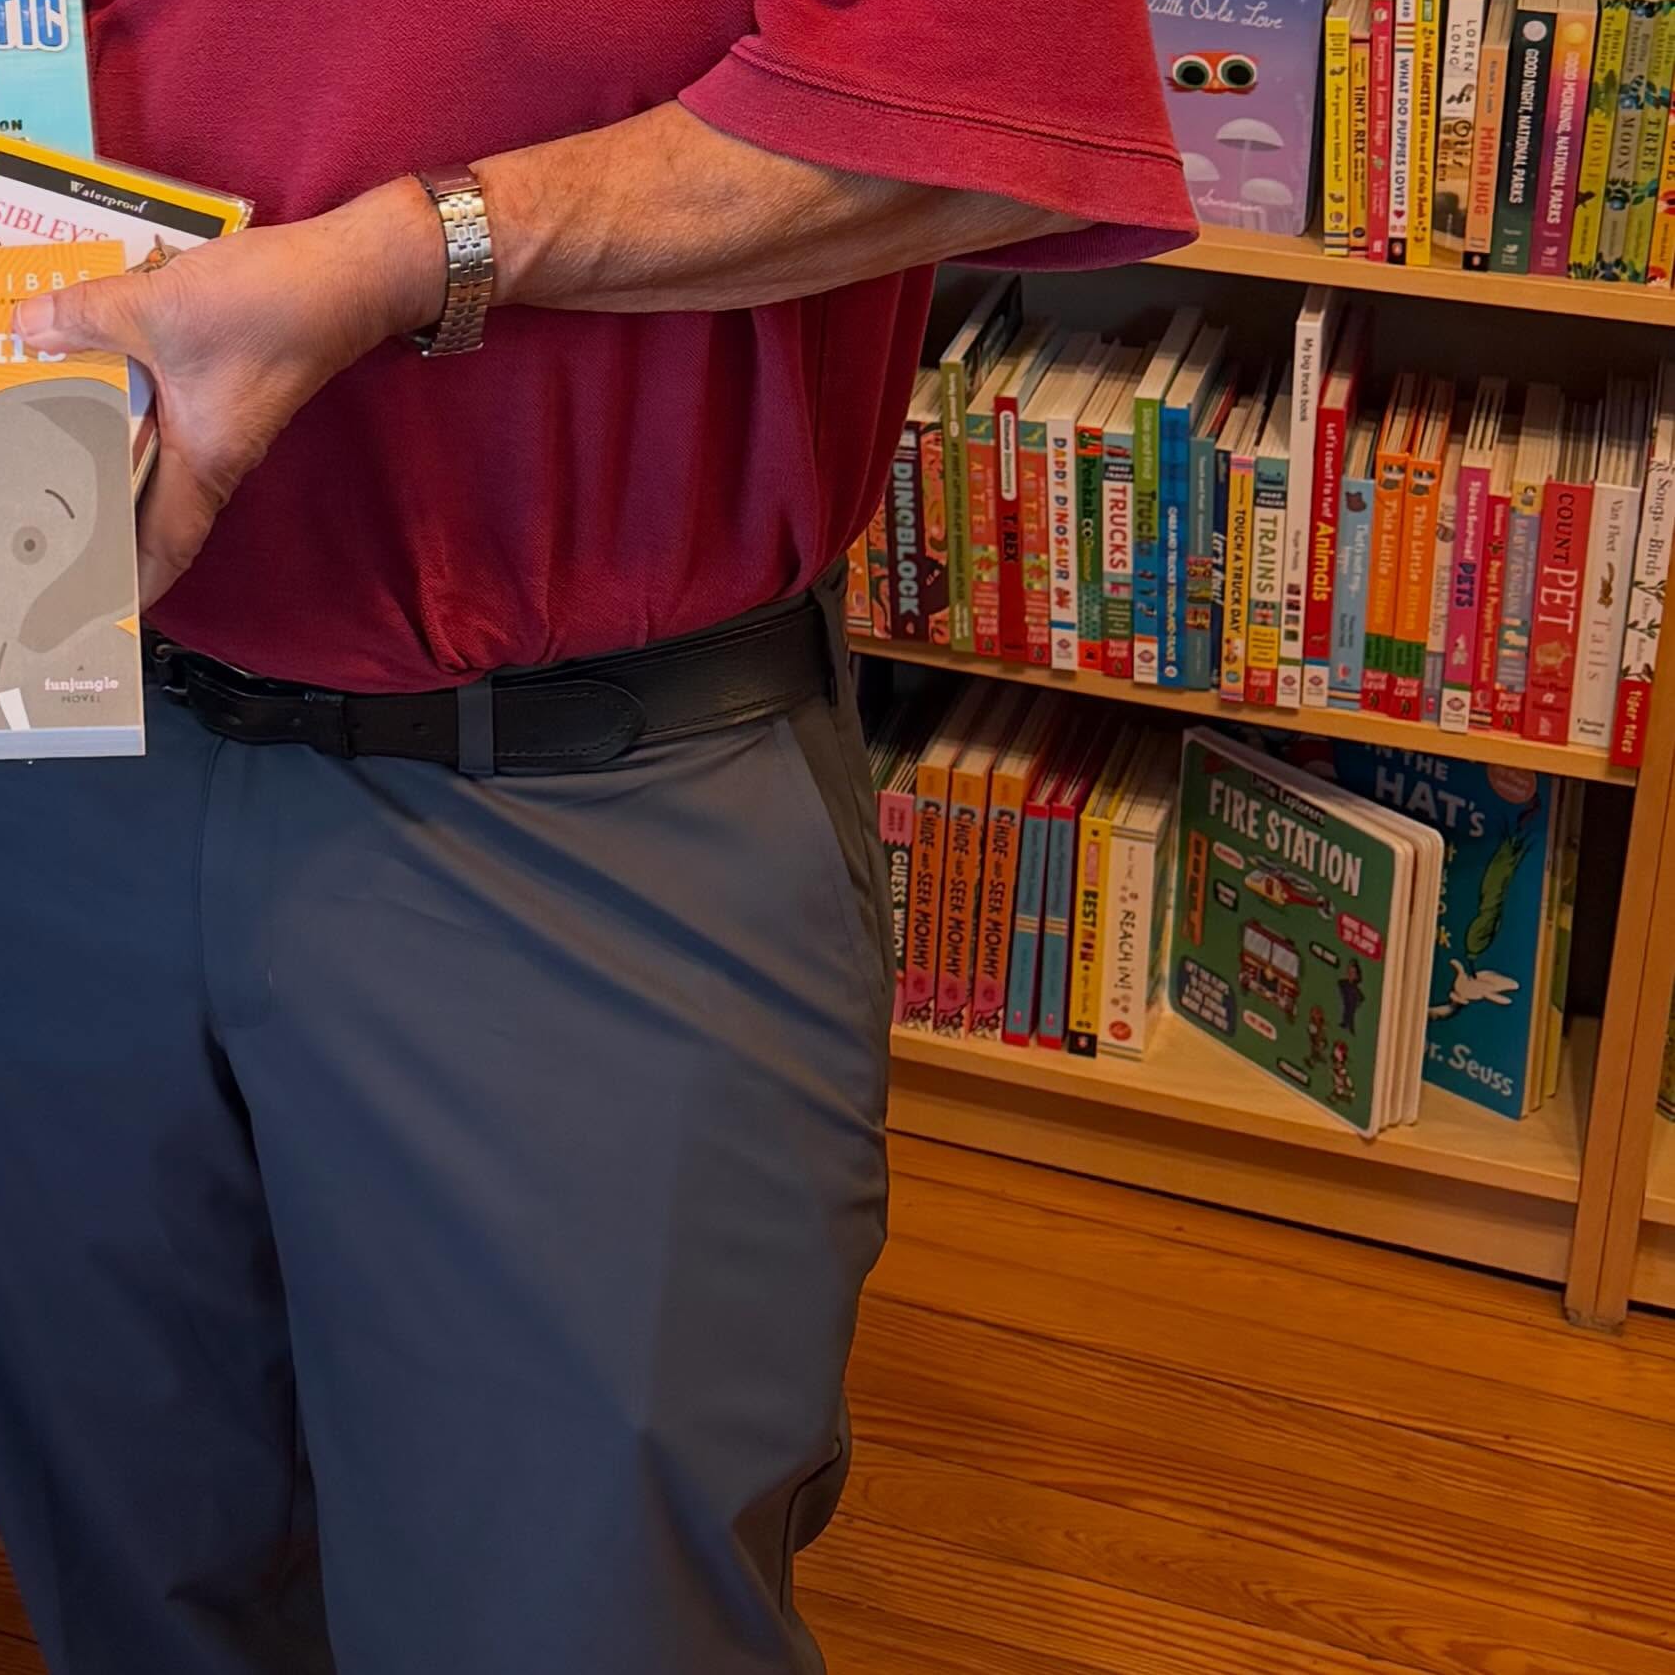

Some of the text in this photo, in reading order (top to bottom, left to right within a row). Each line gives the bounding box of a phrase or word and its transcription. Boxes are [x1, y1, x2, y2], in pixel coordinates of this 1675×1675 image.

[1241, 1, 1283, 29] Love
[1449, 23, 1461, 67] LONG
[1464, 19, 1478, 72] LOREN
[1392, 59, 1411, 206] WHAT DO PUPPIES LOVE?
[1508, 48, 1539, 205] GOOD NATIONAL PARKS
[68, 179, 149, 216] Waterproof
[1474, 127, 1495, 215] MAMA HUG
[1546, 136, 1570, 225] NATIONAL PARKS
[892, 462, 920, 617] DINOBLOCK
[1053, 437, 1069, 579] DADDY DINOSAUR
[1109, 485, 1128, 571] TRUCKS
[1227, 510, 1248, 633] TOUCH TRUCK DAY
[1256, 515, 1278, 595] TRAINS
[1313, 521, 1336, 602] Animals
[1454, 563, 1477, 608] PETS
[1538, 492, 1578, 634] COUNT PET
[45, 677, 119, 691] funjungle
[1209, 778, 1363, 897] FIRE STATION
[1375, 766, 1486, 838] HAT'S
[911, 872, 932, 968] SEEK MOMMY
[945, 879, 966, 976] SEEK MOMMY
[984, 880, 1006, 978] SEEK MOMMY
[1082, 889, 1099, 928] BEST
[1116, 909, 1139, 962] REACH
[1448, 1043, 1513, 1097] Seuss
